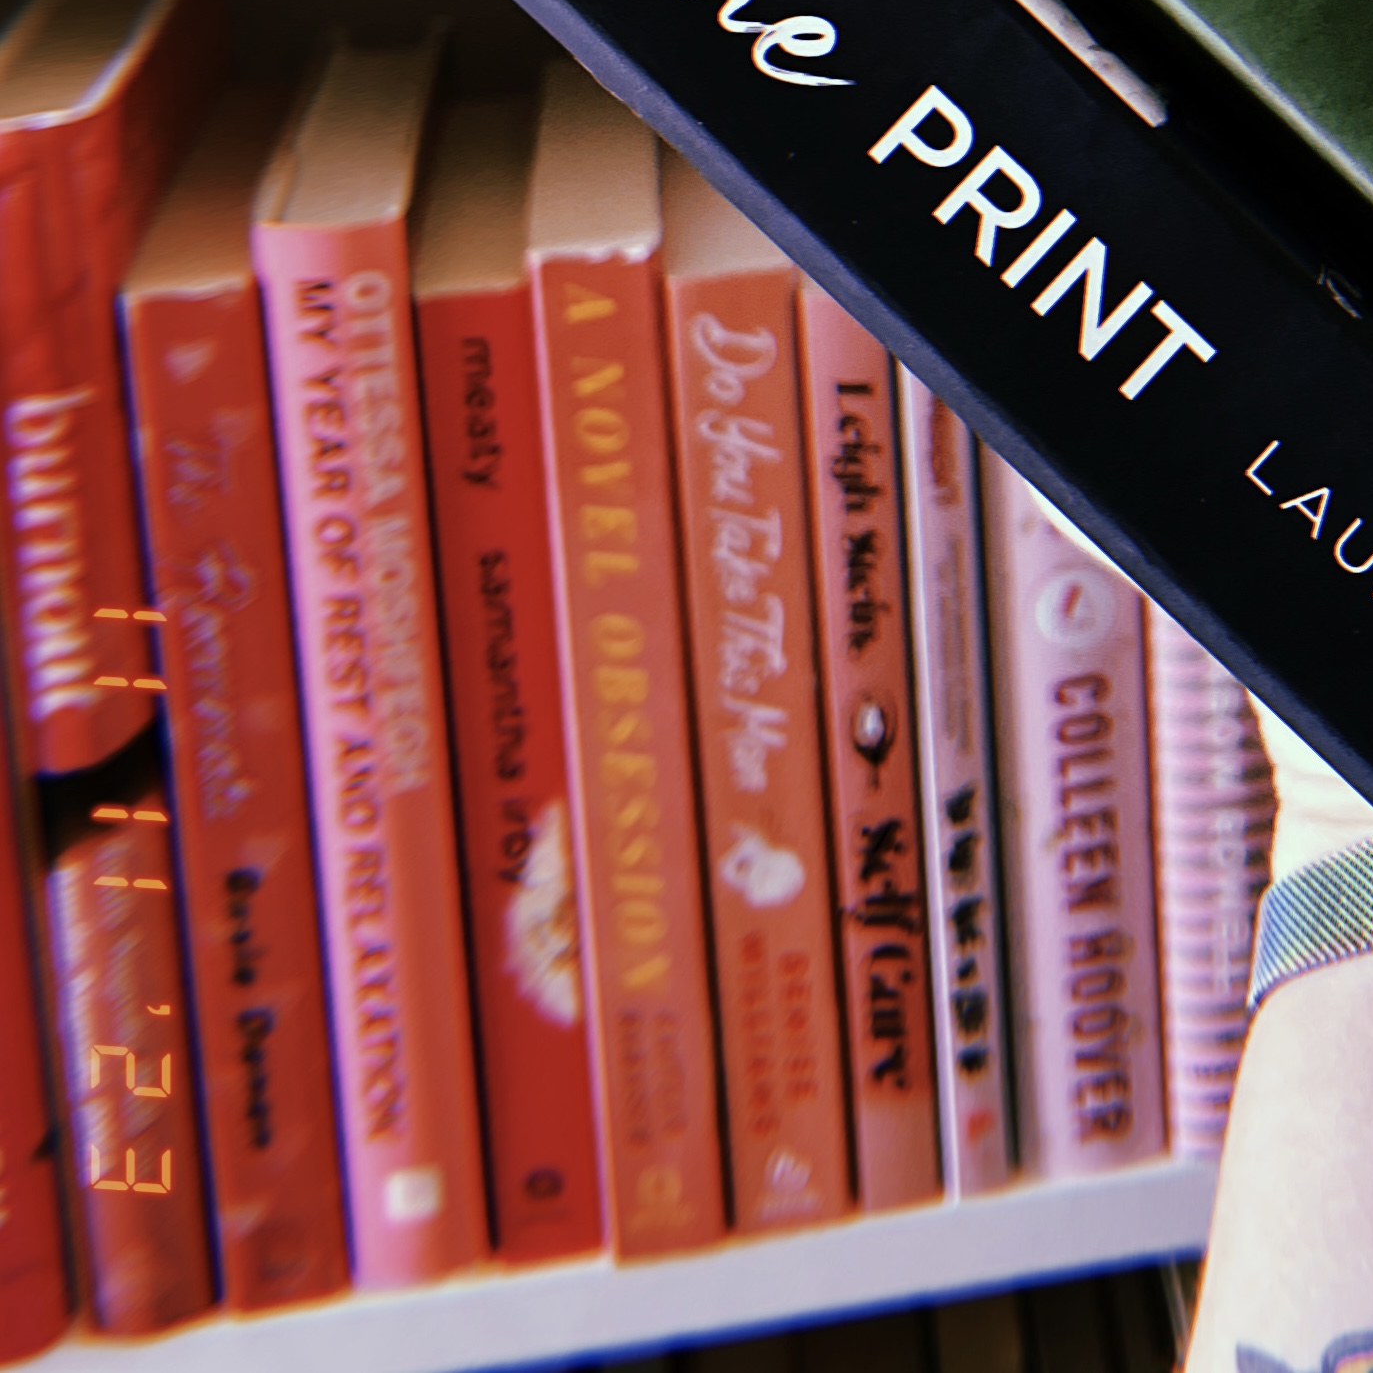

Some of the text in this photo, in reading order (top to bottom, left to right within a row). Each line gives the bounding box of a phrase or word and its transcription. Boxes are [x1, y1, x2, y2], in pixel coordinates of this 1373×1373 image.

[563, 282, 617, 323] A
[866, 84, 1218, 402] PRINT
[341, 269, 407, 508] OTTESSA
[459, 335, 499, 489] meaty
[686, 312, 779, 406] Do
[571, 356, 641, 588] NOVEL
[696, 409, 783, 505] You
[833, 380, 883, 515] Leigh
[707, 505, 783, 604] Take
[295, 276, 408, 1144] MY YEAR OF REST AND RELAXATION
[478, 548, 528, 781] samantha
[721, 593, 789, 697] This
[589, 612, 671, 991] OBSESSION
[1054, 672, 1134, 1146] COLLEEN HOOVER
[866, 943, 918, 1093] Care
